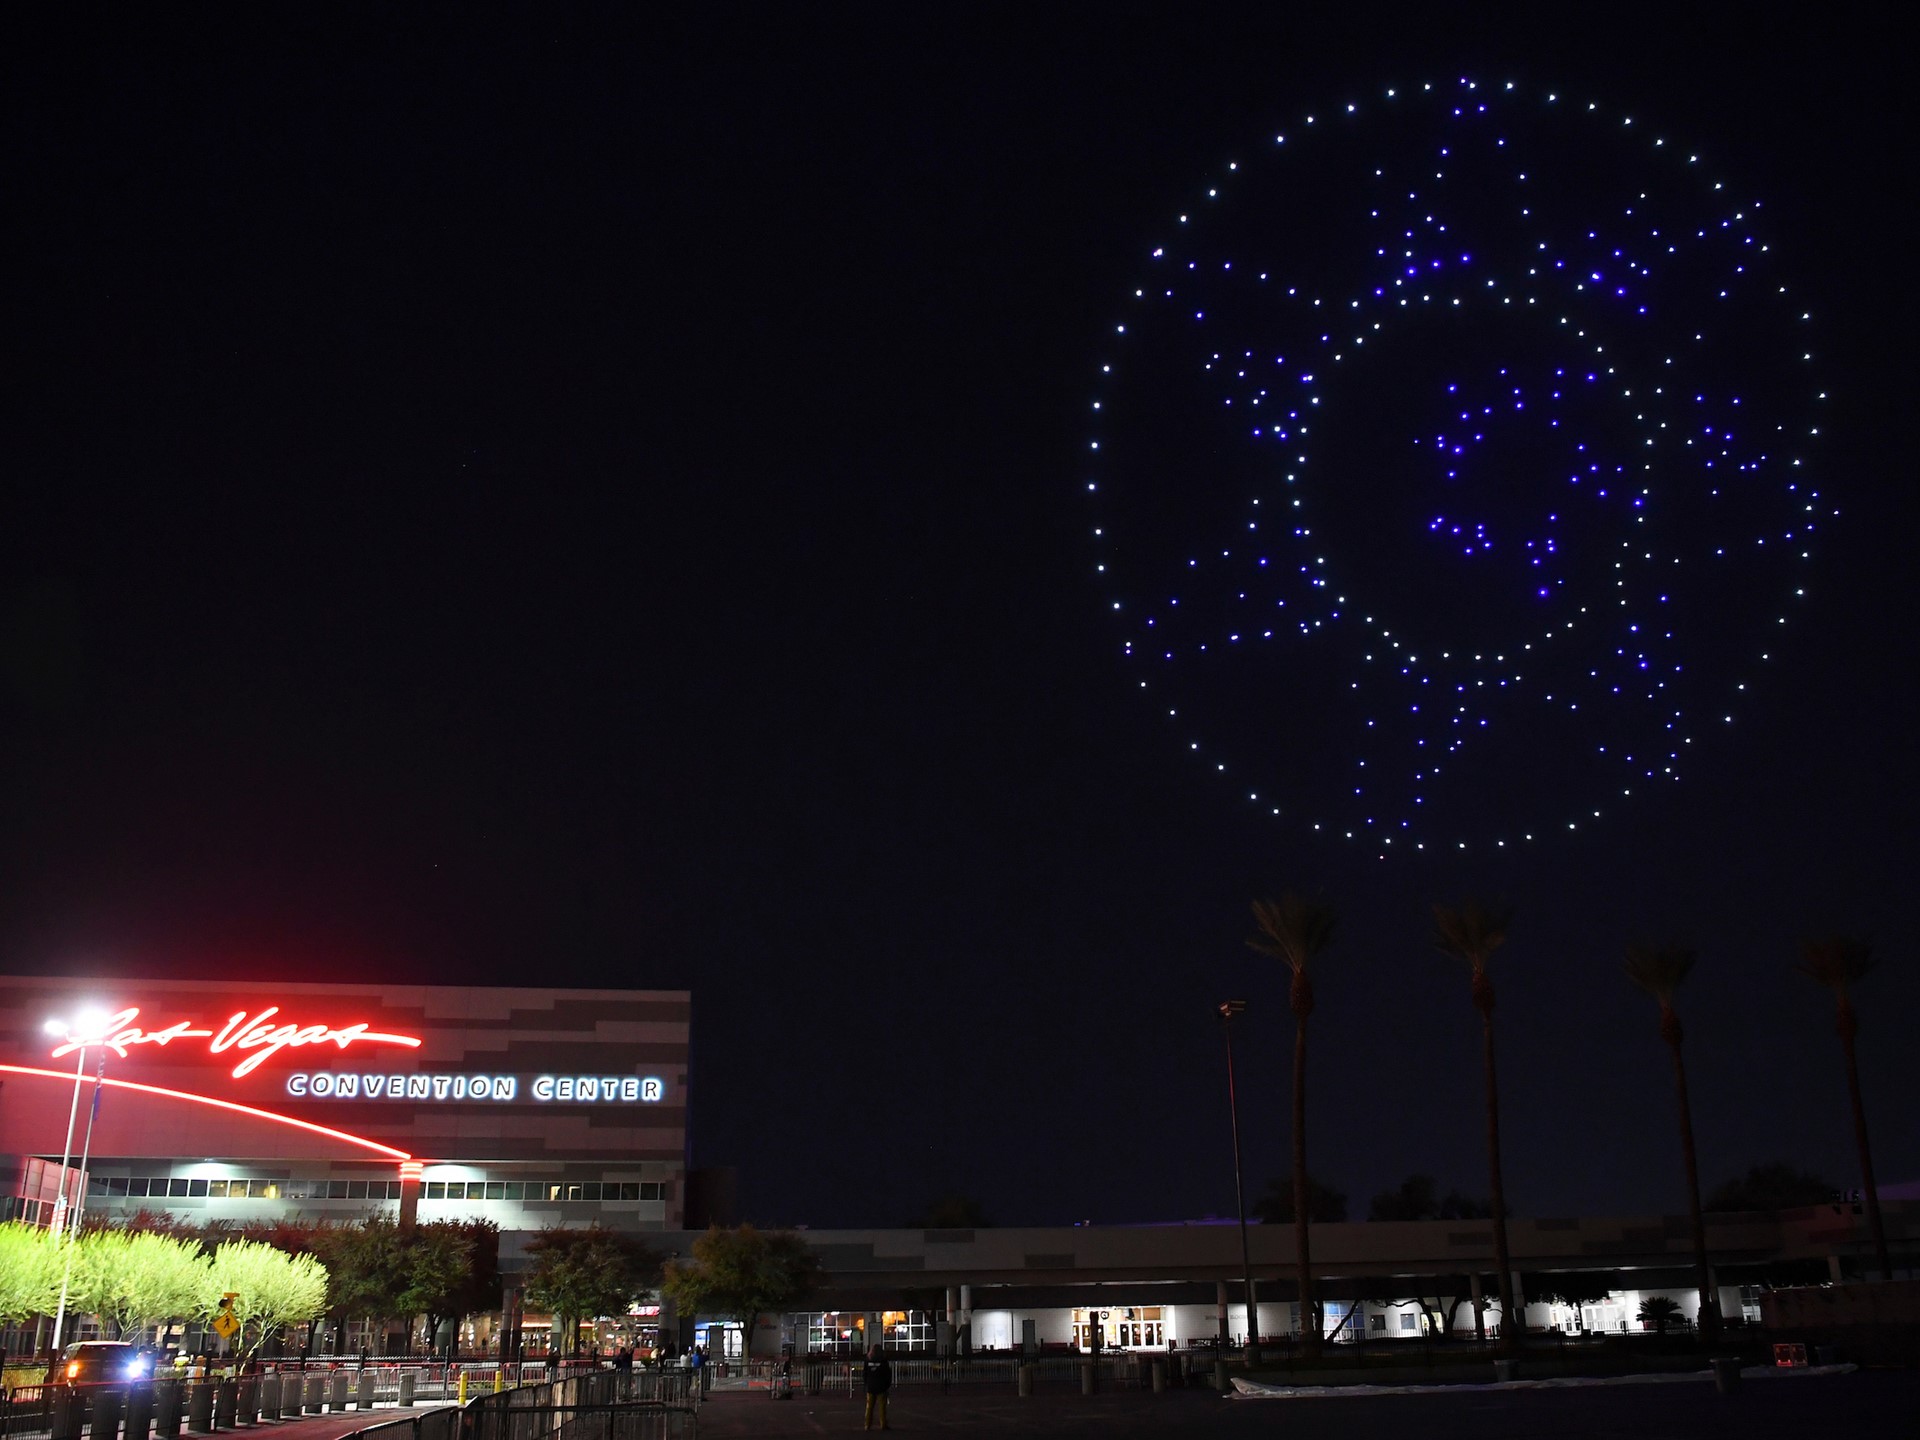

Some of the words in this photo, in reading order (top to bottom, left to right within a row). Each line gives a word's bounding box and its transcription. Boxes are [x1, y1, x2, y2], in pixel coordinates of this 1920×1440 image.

[52, 1006, 213, 1059] Las
[210, 1006, 422, 1079] Vegas
[287, 1072, 516, 1100] CONVENTION
[533, 1075, 662, 1101] CENTER
